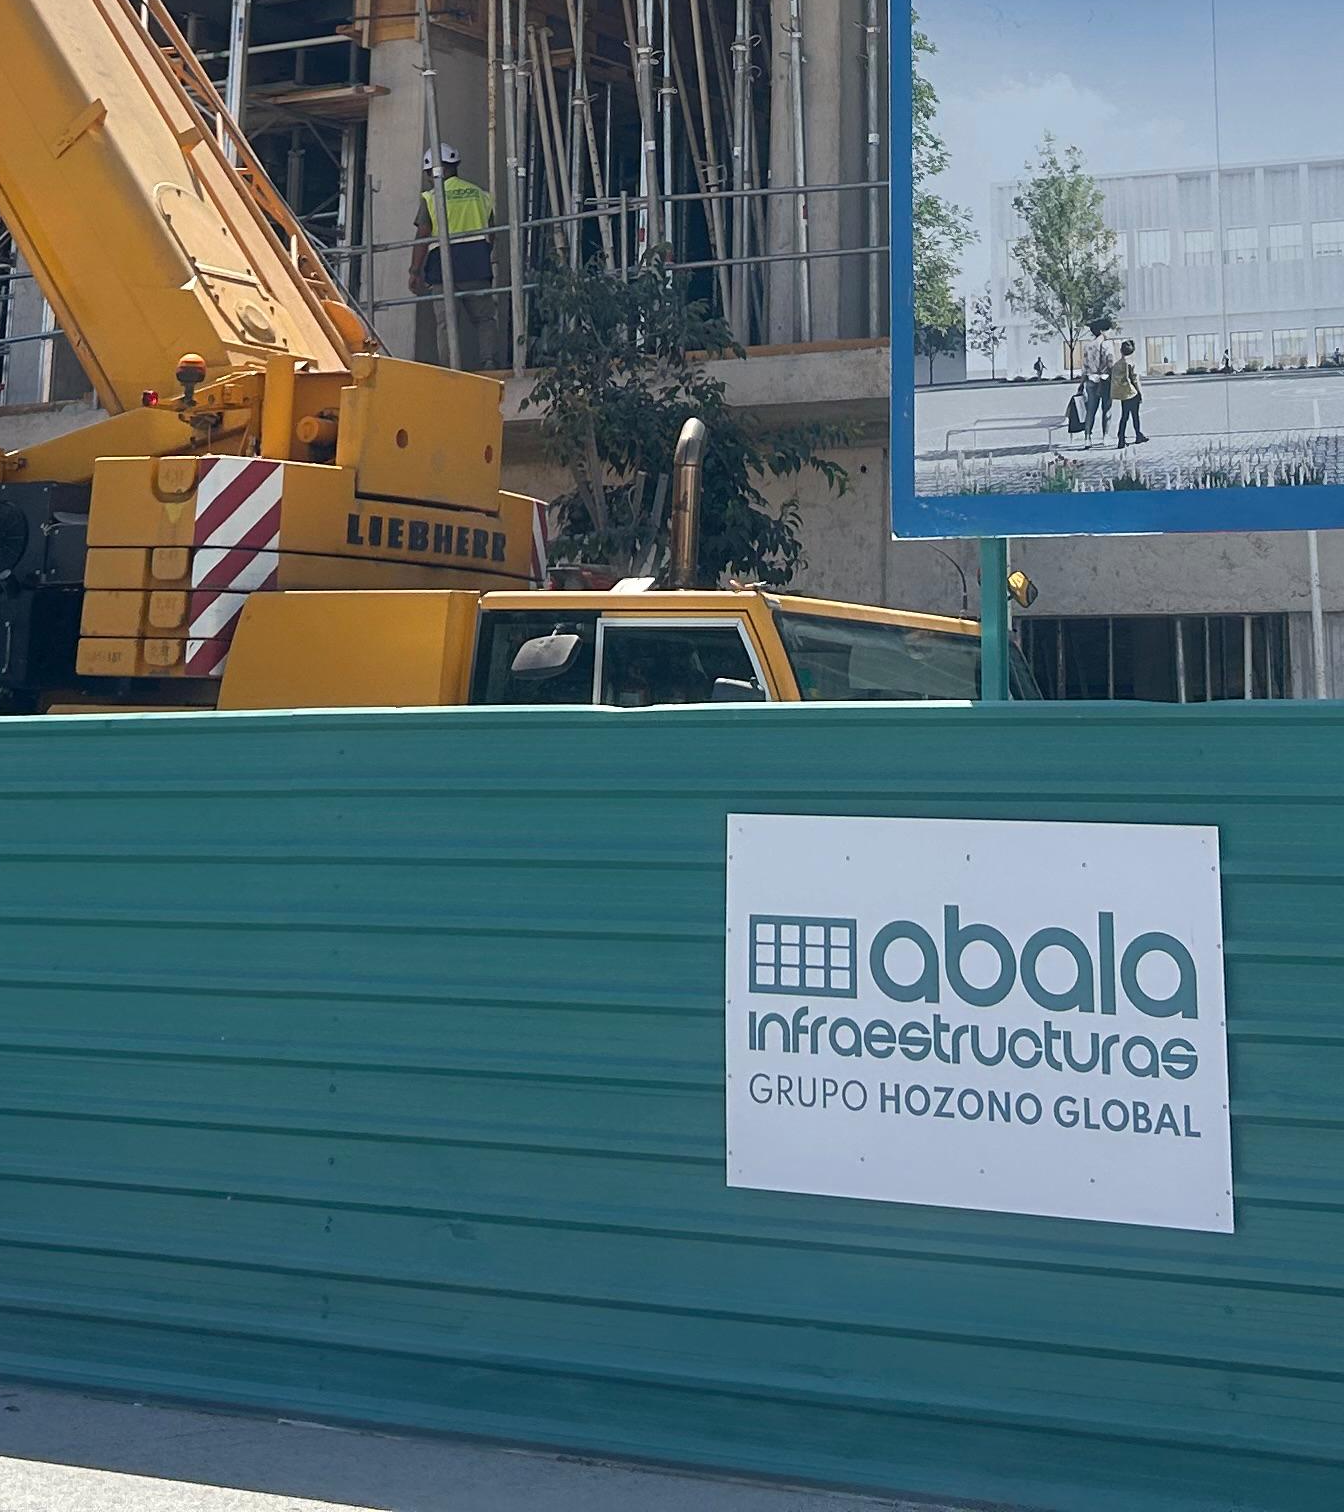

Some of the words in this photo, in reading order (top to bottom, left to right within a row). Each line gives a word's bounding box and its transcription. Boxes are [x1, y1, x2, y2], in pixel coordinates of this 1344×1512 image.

[347, 513, 506, 562] LIEBHERR
[869, 904, 1198, 1019] abala
[748, 1005, 1198, 1080] infraestructuras
[749, 1072, 868, 1112] GRUPO
[879, 1081, 1043, 1126] HOZONO
[1053, 1095, 1201, 1138] GLOBAL
